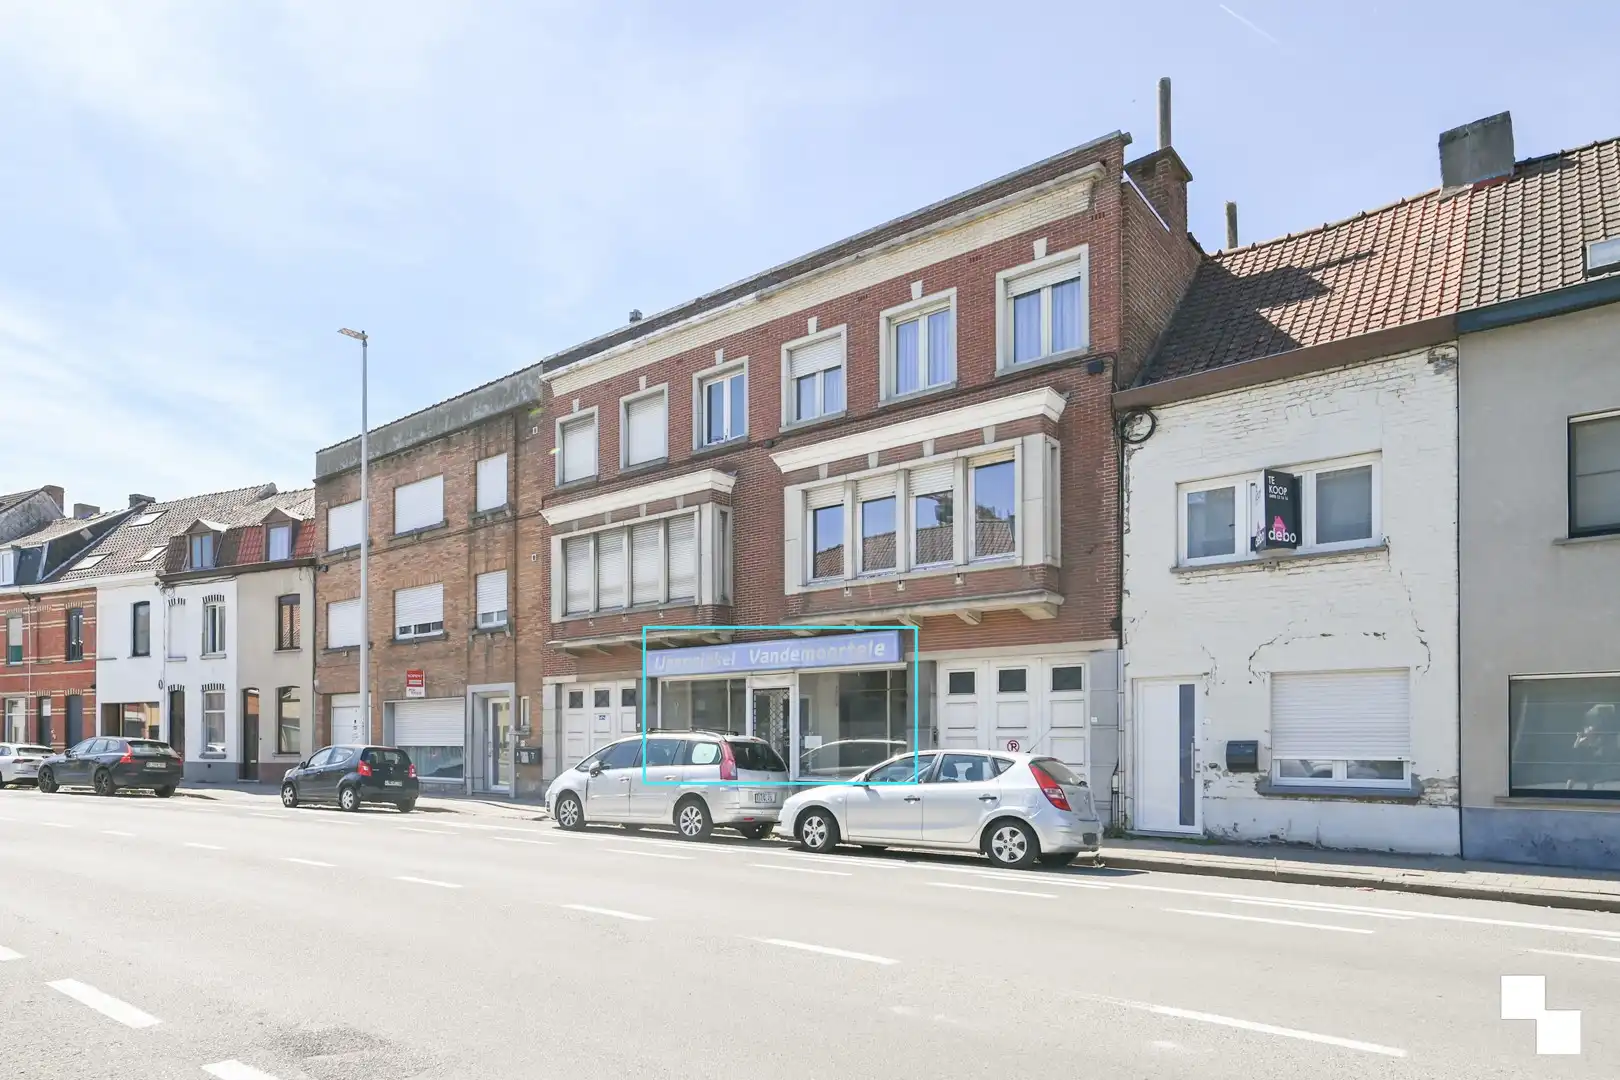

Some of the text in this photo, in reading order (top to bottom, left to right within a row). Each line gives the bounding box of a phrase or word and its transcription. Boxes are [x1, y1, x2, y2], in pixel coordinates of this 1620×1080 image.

[1268, 475, 1275, 485] TE
[1268, 485, 1287, 495] KOOP
[1268, 528, 1296, 543] debo
